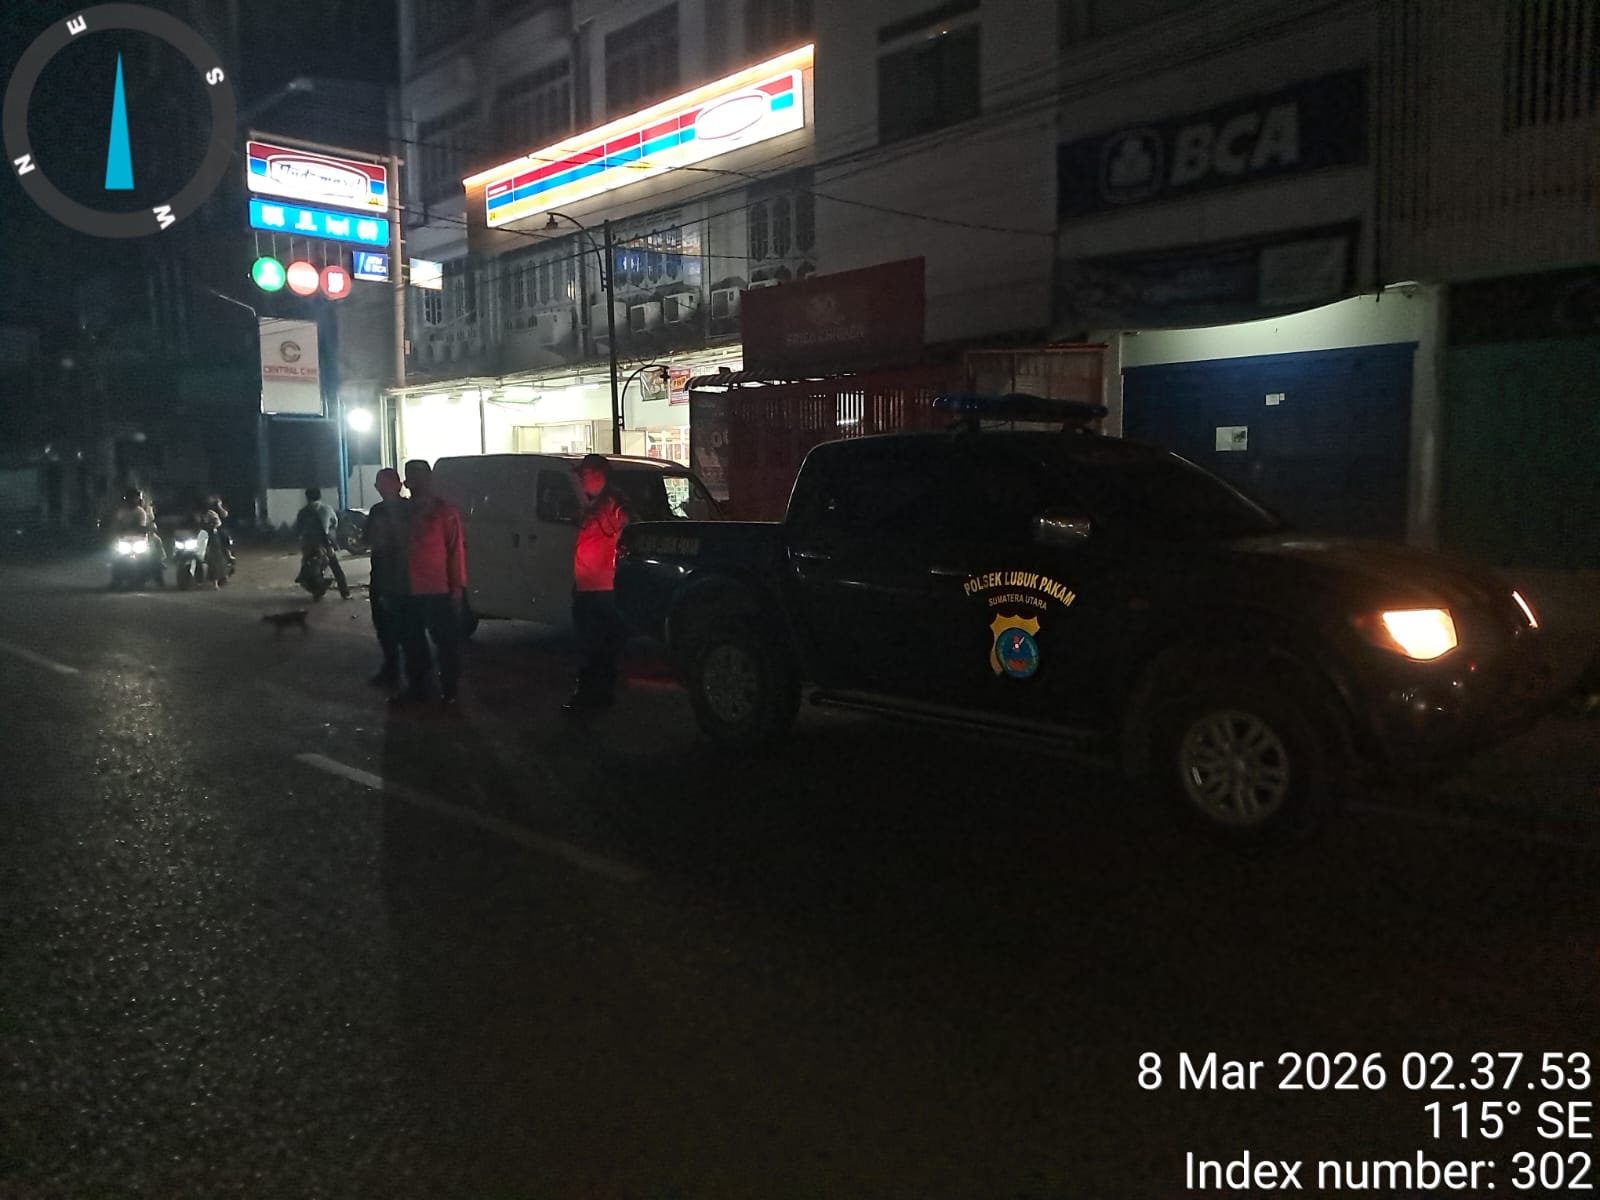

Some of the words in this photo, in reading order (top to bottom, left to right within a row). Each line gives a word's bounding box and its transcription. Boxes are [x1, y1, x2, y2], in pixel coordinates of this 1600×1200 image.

[1168, 103, 1299, 187] BCA
[964, 571, 1002, 596] POLSEK
[1004, 571, 1040, 589] LUBUK
[1038, 576, 1076, 607] PAKAM
[988, 593, 1024, 607] SUMATERA
[1025, 595, 1047, 610] UTARA
